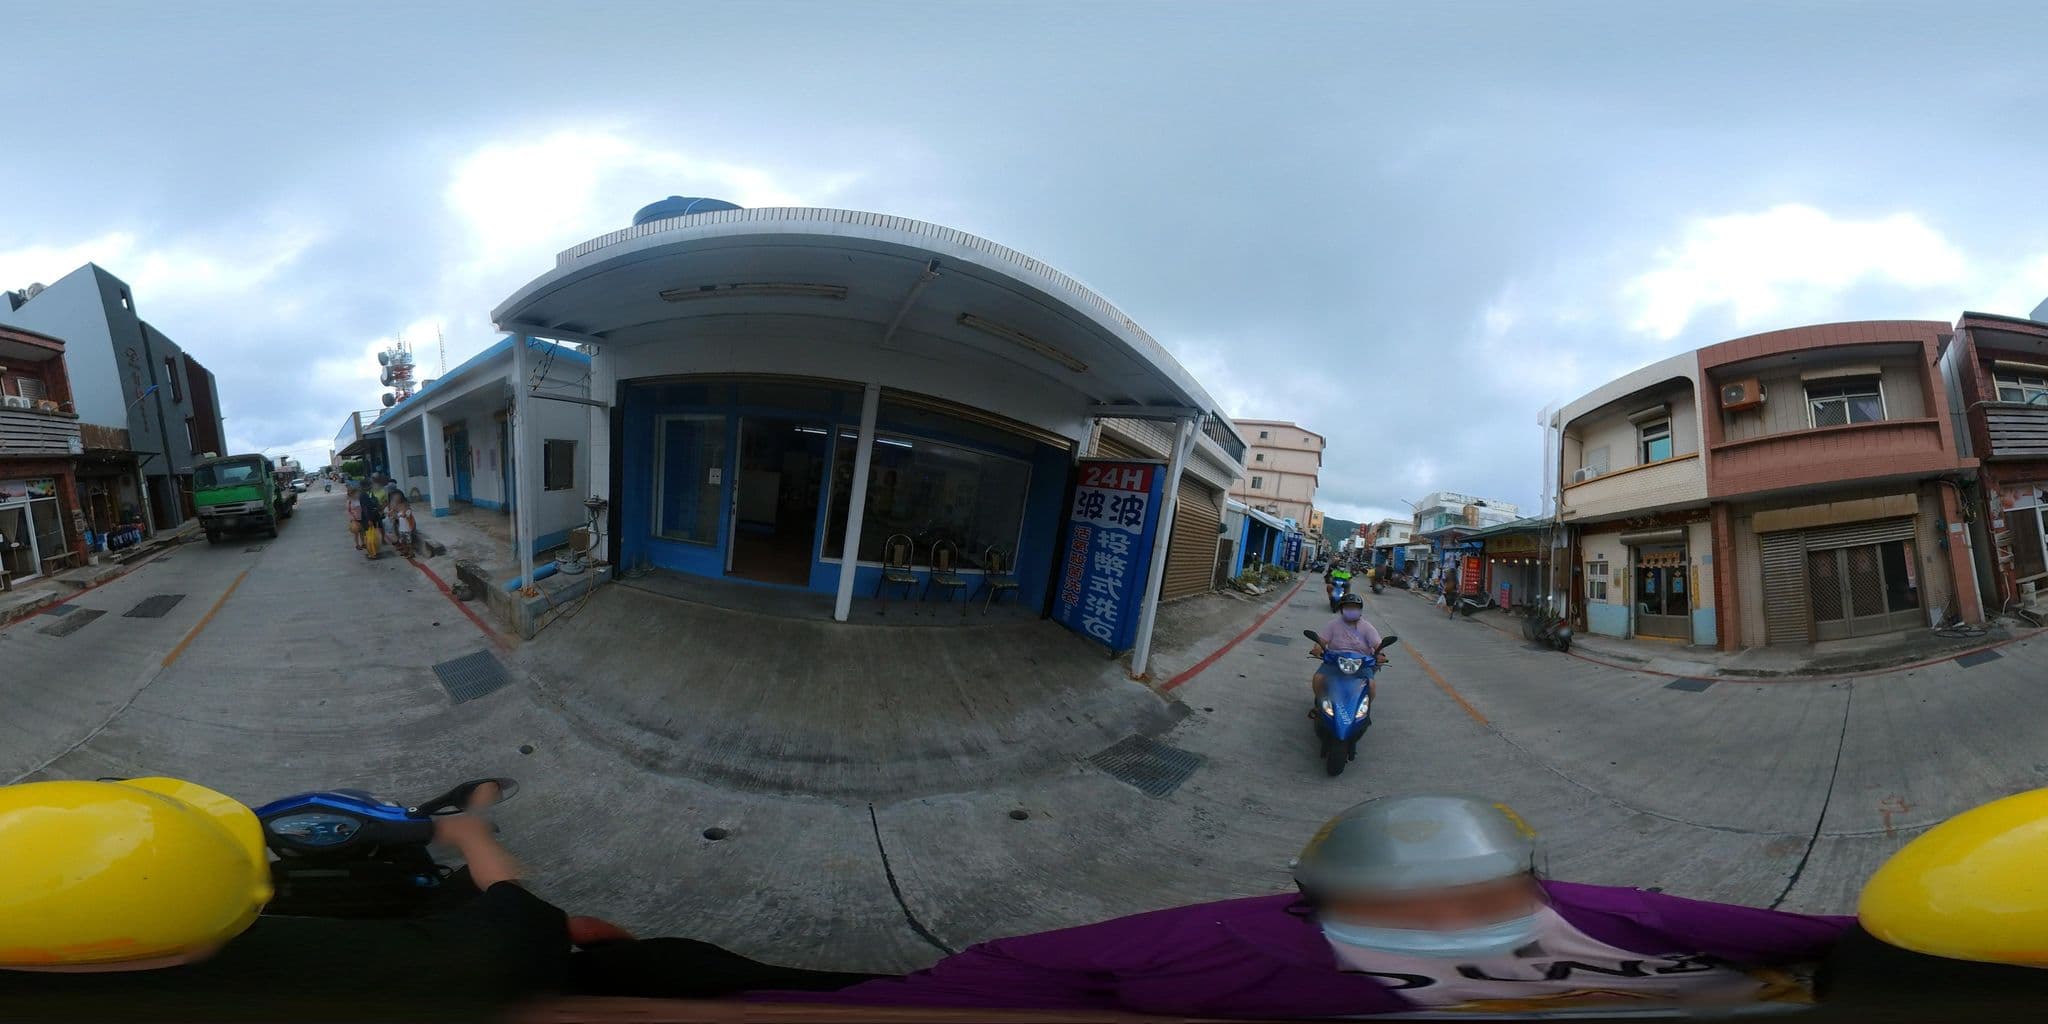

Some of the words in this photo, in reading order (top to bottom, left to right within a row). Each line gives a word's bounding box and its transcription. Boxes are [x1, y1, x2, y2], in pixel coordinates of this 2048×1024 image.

[1087, 467, 1144, 491] 24H
[1077, 490, 1145, 527] 波波
[1082, 530, 1131, 643] 投幣式洗衣
